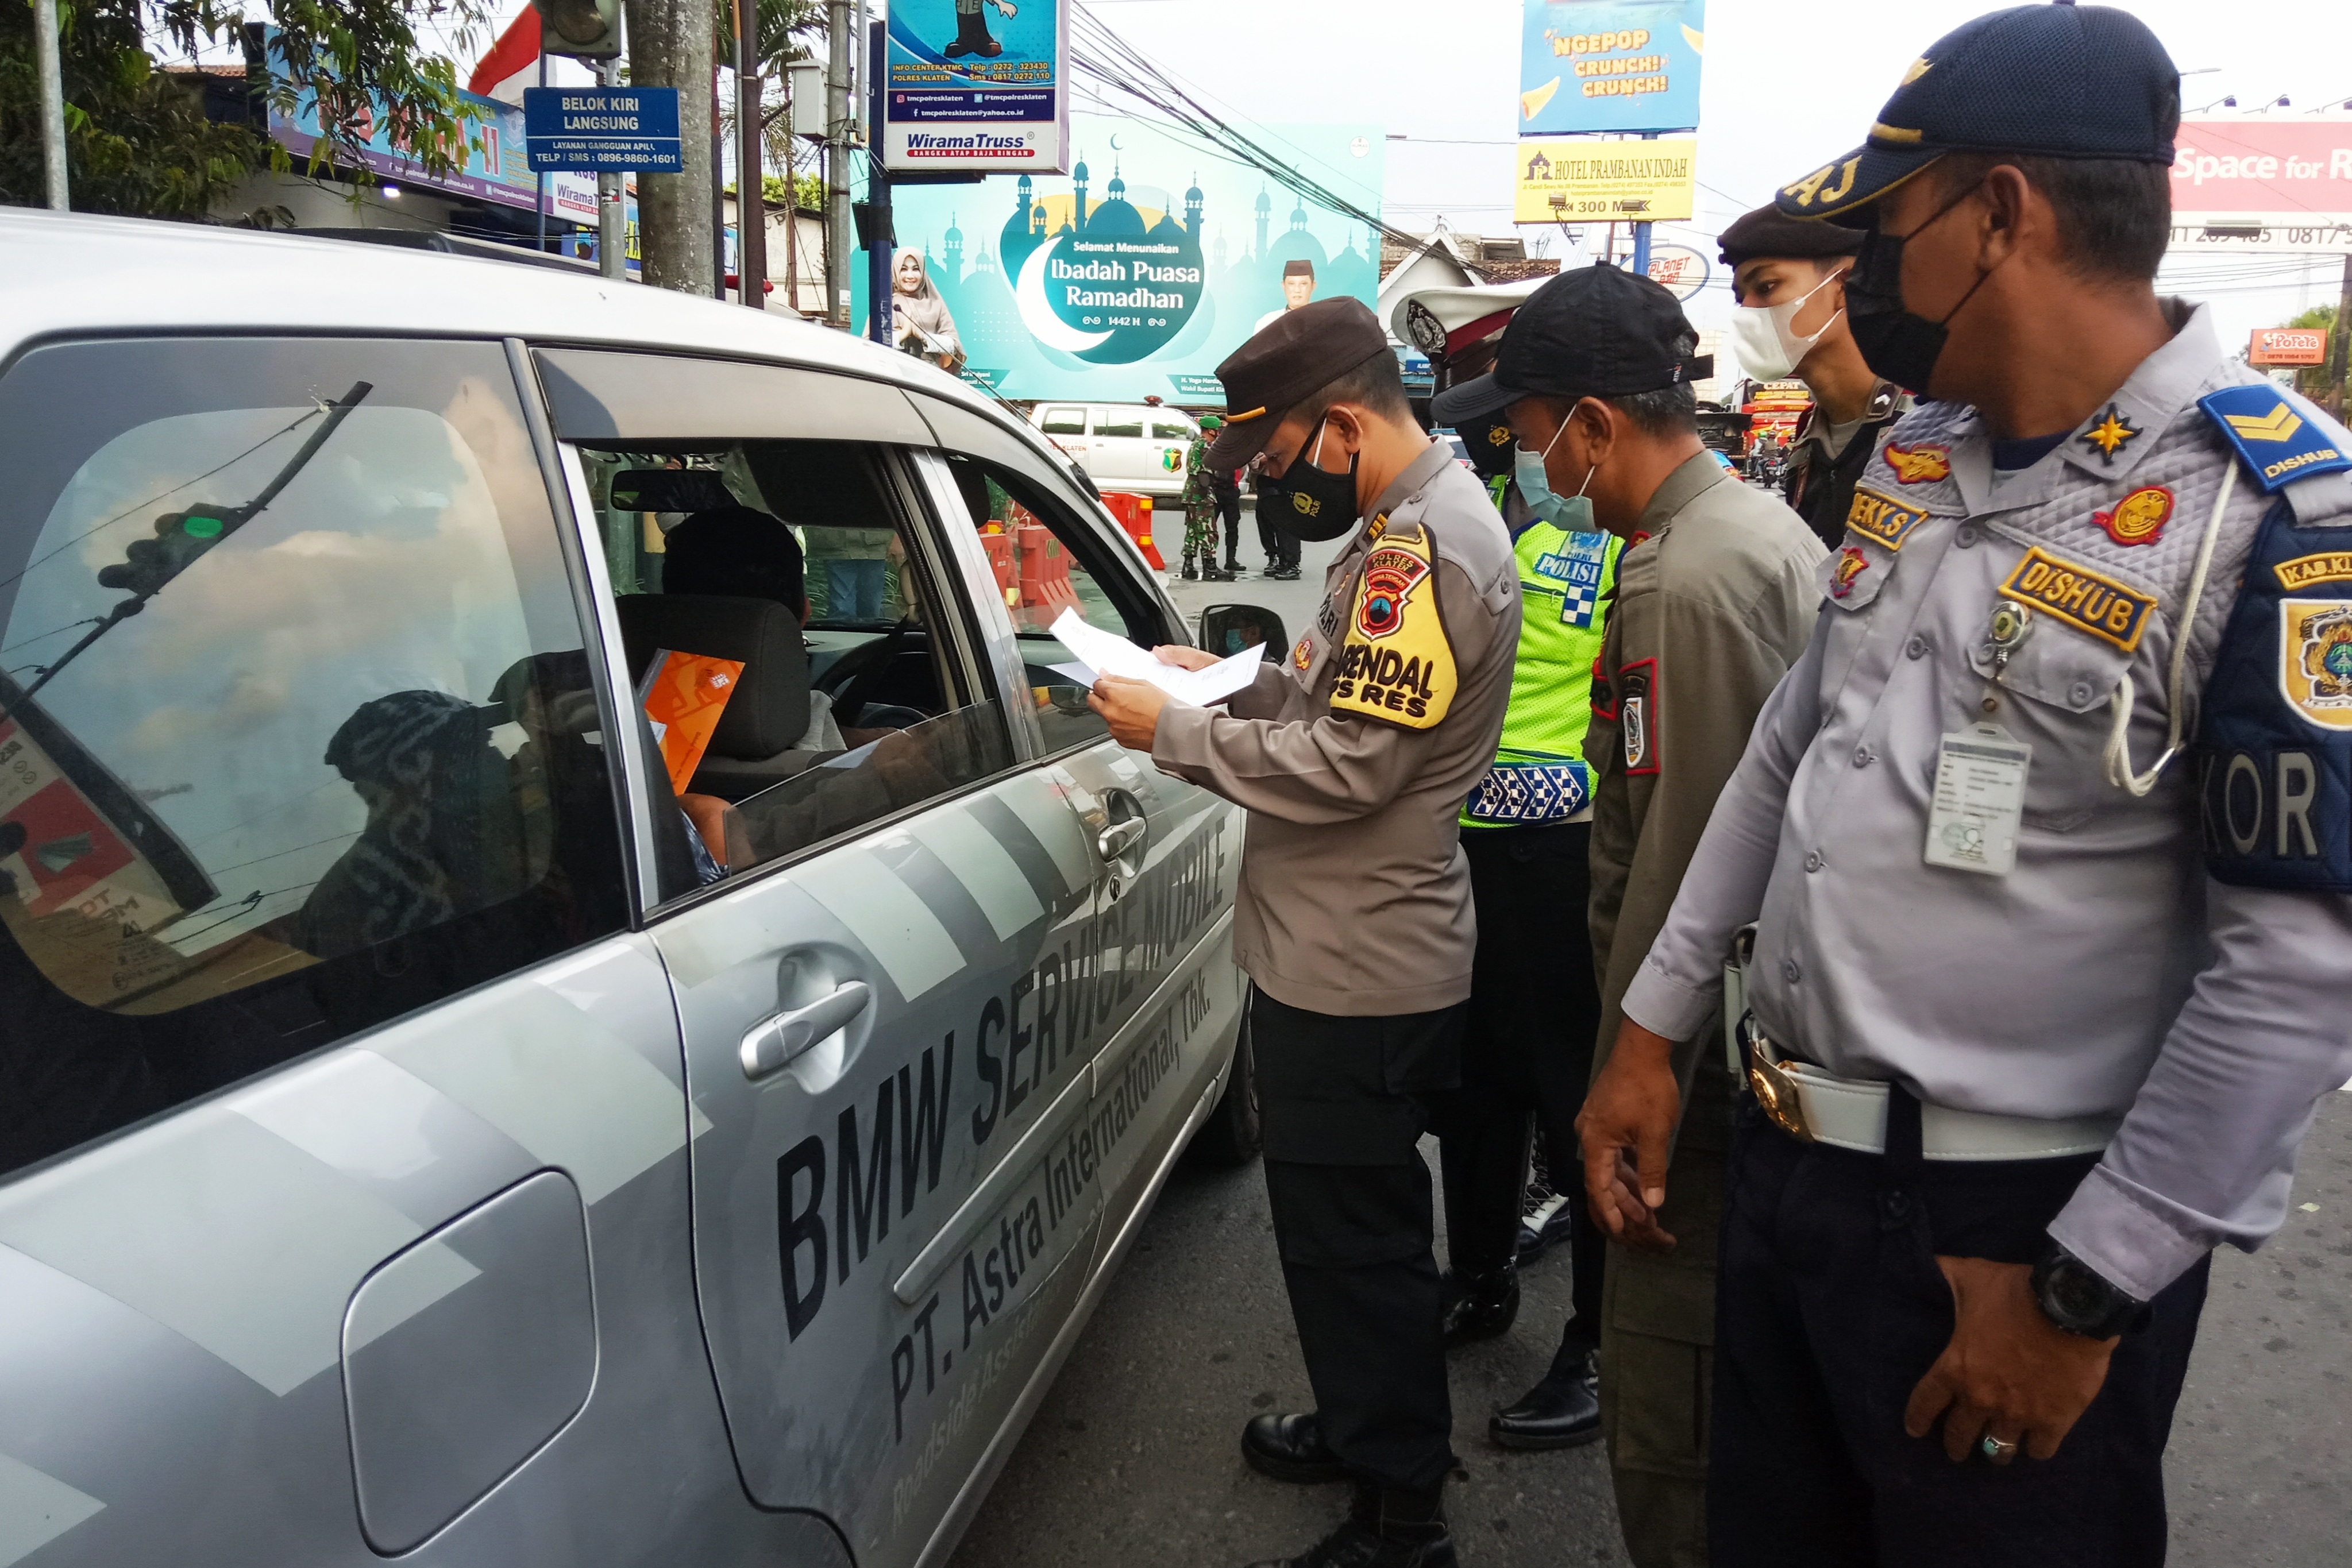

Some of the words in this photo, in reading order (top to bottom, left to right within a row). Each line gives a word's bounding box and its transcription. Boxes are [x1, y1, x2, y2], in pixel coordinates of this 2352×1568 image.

[1553, 29, 1649, 56] NGEPOP
[969, 63, 986, 72] Telp
[1575, 55, 1660, 77] CRUNCH!
[1582, 76, 1668, 97] CRUNCH!
[562, 97, 607, 111] BELOK
[611, 97, 639, 111] KIRI
[907, 95, 963, 103] tmcpolresklaten
[984, 94, 1047, 102] @tmcpolresklaten
[921, 109, 1024, 117] tmcpolresklaten@yahoo.co.id
[564, 117, 639, 130] LANGSUNG
[588, 142, 631, 150] GANGGUAN
[908, 133, 1024, 149] WiramaTruss
[536, 153, 561, 162] TELP
[568, 153, 589, 162] SMS
[597, 153, 676, 164] 0896-9860-1601
[2172, 146, 2278, 186] Space
[2285, 155, 2324, 179] for
[1555, 160, 1587, 180] HOTEL
[1590, 159, 1653, 179] PRAMBANAN
[1653, 159, 1687, 178] INDAH
[557, 183, 599, 207] WiramaT
[1578, 201, 1606, 213] 300
[1073, 241, 1114, 253] Selamat
[1116, 242, 1179, 254] Menunaikan
[1051, 258, 1126, 281] Ibadah
[1132, 260, 1200, 283] Puasa
[1649, 256, 1691, 275] PLANET
[1065, 285, 1184, 309] Ramadhan
[1108, 316, 1131, 326] 1442
[1132, 318, 1141, 326] H
[1763, 381, 1800, 390] CEPAT
[2264, 449, 2339, 478] DISHUB
[1309, 500, 1321, 517] POLRI
[1372, 553, 1414, 568] POLRES
[1374, 560, 1409, 571] KLATEN
[1537, 555, 1600, 584] POLISI
[2285, 556, 2352, 582] KAB.KL
[2019, 562, 2134, 632] DISHUB
[1360, 683, 1427, 718] RES
[777, 1031, 955, 1343] BMW
[972, 891, 1138, 1146] SERVICE
[1140, 816, 1225, 984] MOBILE
[891, 1291, 952, 1446] PT.
[963, 1195, 1044, 1351] Astra
[1045, 1005, 1180, 1231] International,
[1180, 968, 1210, 1042] Tbk.
